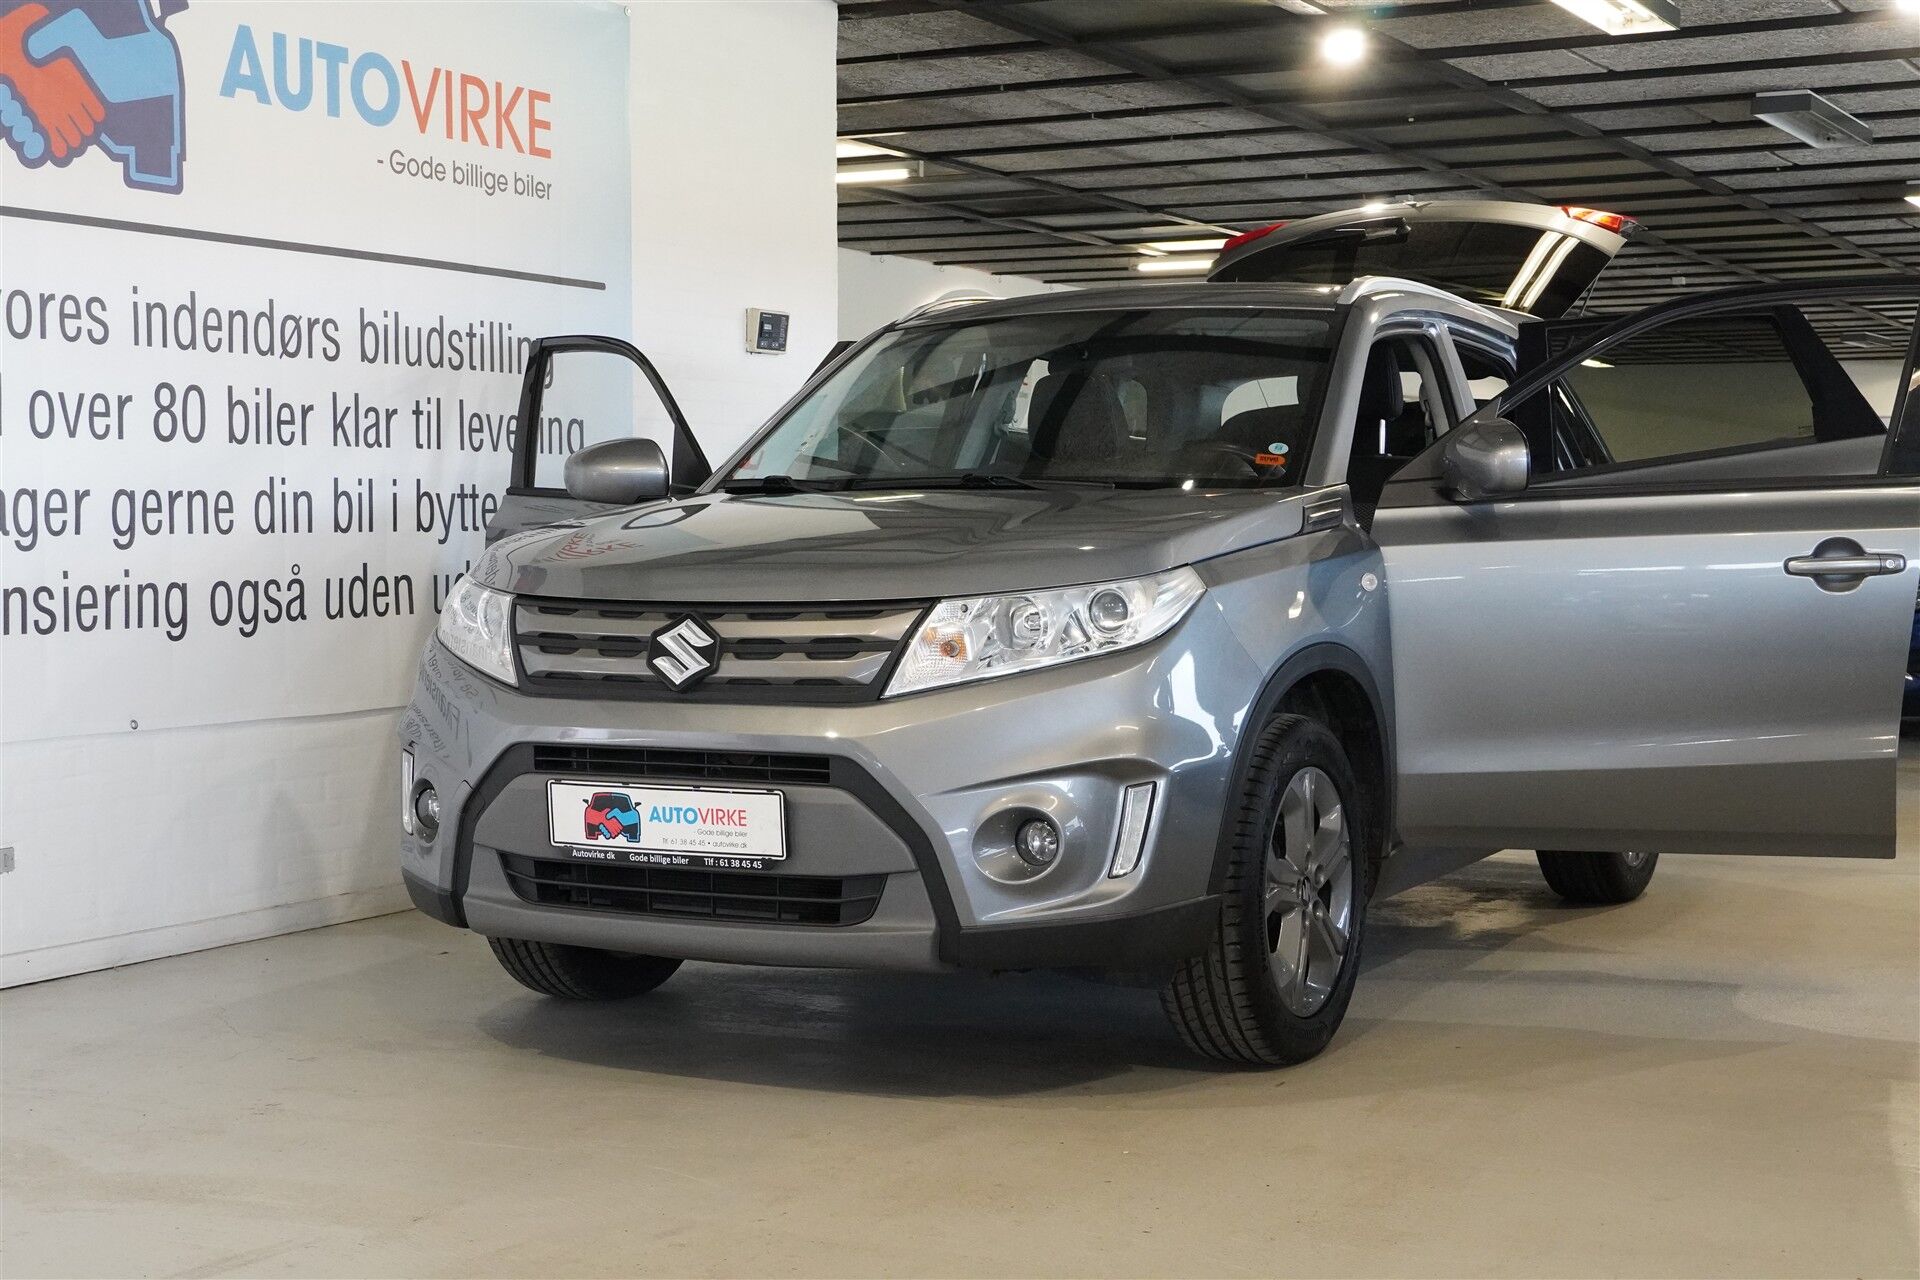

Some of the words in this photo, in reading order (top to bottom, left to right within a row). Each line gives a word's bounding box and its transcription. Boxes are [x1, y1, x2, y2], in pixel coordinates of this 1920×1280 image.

[219, 24, 551, 159] AUTOVIRKE
[389, 149, 447, 182] Gode
[452, 160, 508, 196] billige
[514, 172, 552, 200] biler
[0, 289, 110, 345] ores
[132, 286, 341, 363] indendørs
[360, 307, 554, 389] biludstillin
[29, 389, 133, 440] over
[153, 382, 206, 444] 80
[227, 386, 314, 446] biler
[332, 391, 398, 450] klar
[411, 397, 442, 450] til
[459, 400, 584, 454] leveing
[112, 487, 234, 550] gerne
[255, 476, 313, 535] din
[333, 478, 374, 534] bil
[391, 478, 399, 533] i
[416, 478, 498, 544] bytte
[3, 568, 188, 641] nsiering
[210, 563, 307, 638] også
[325, 562, 415, 620] uden
[649, 806, 748, 827] AUTOVIRKE
[697, 828, 715, 837] Gode
[716, 829, 733, 839] billige
[735, 830, 748, 838] biler
[572, 849, 605, 860] Autovirke
[606, 851, 616, 860] dk
[629, 853, 648, 862] Gode
[649, 854, 670, 865] billige
[672, 855, 689, 865] biler
[720, 858, 729, 867] 61
[731, 859, 740, 868] 38
[741, 860, 751, 868] 45
[752, 861, 762, 869] 45
